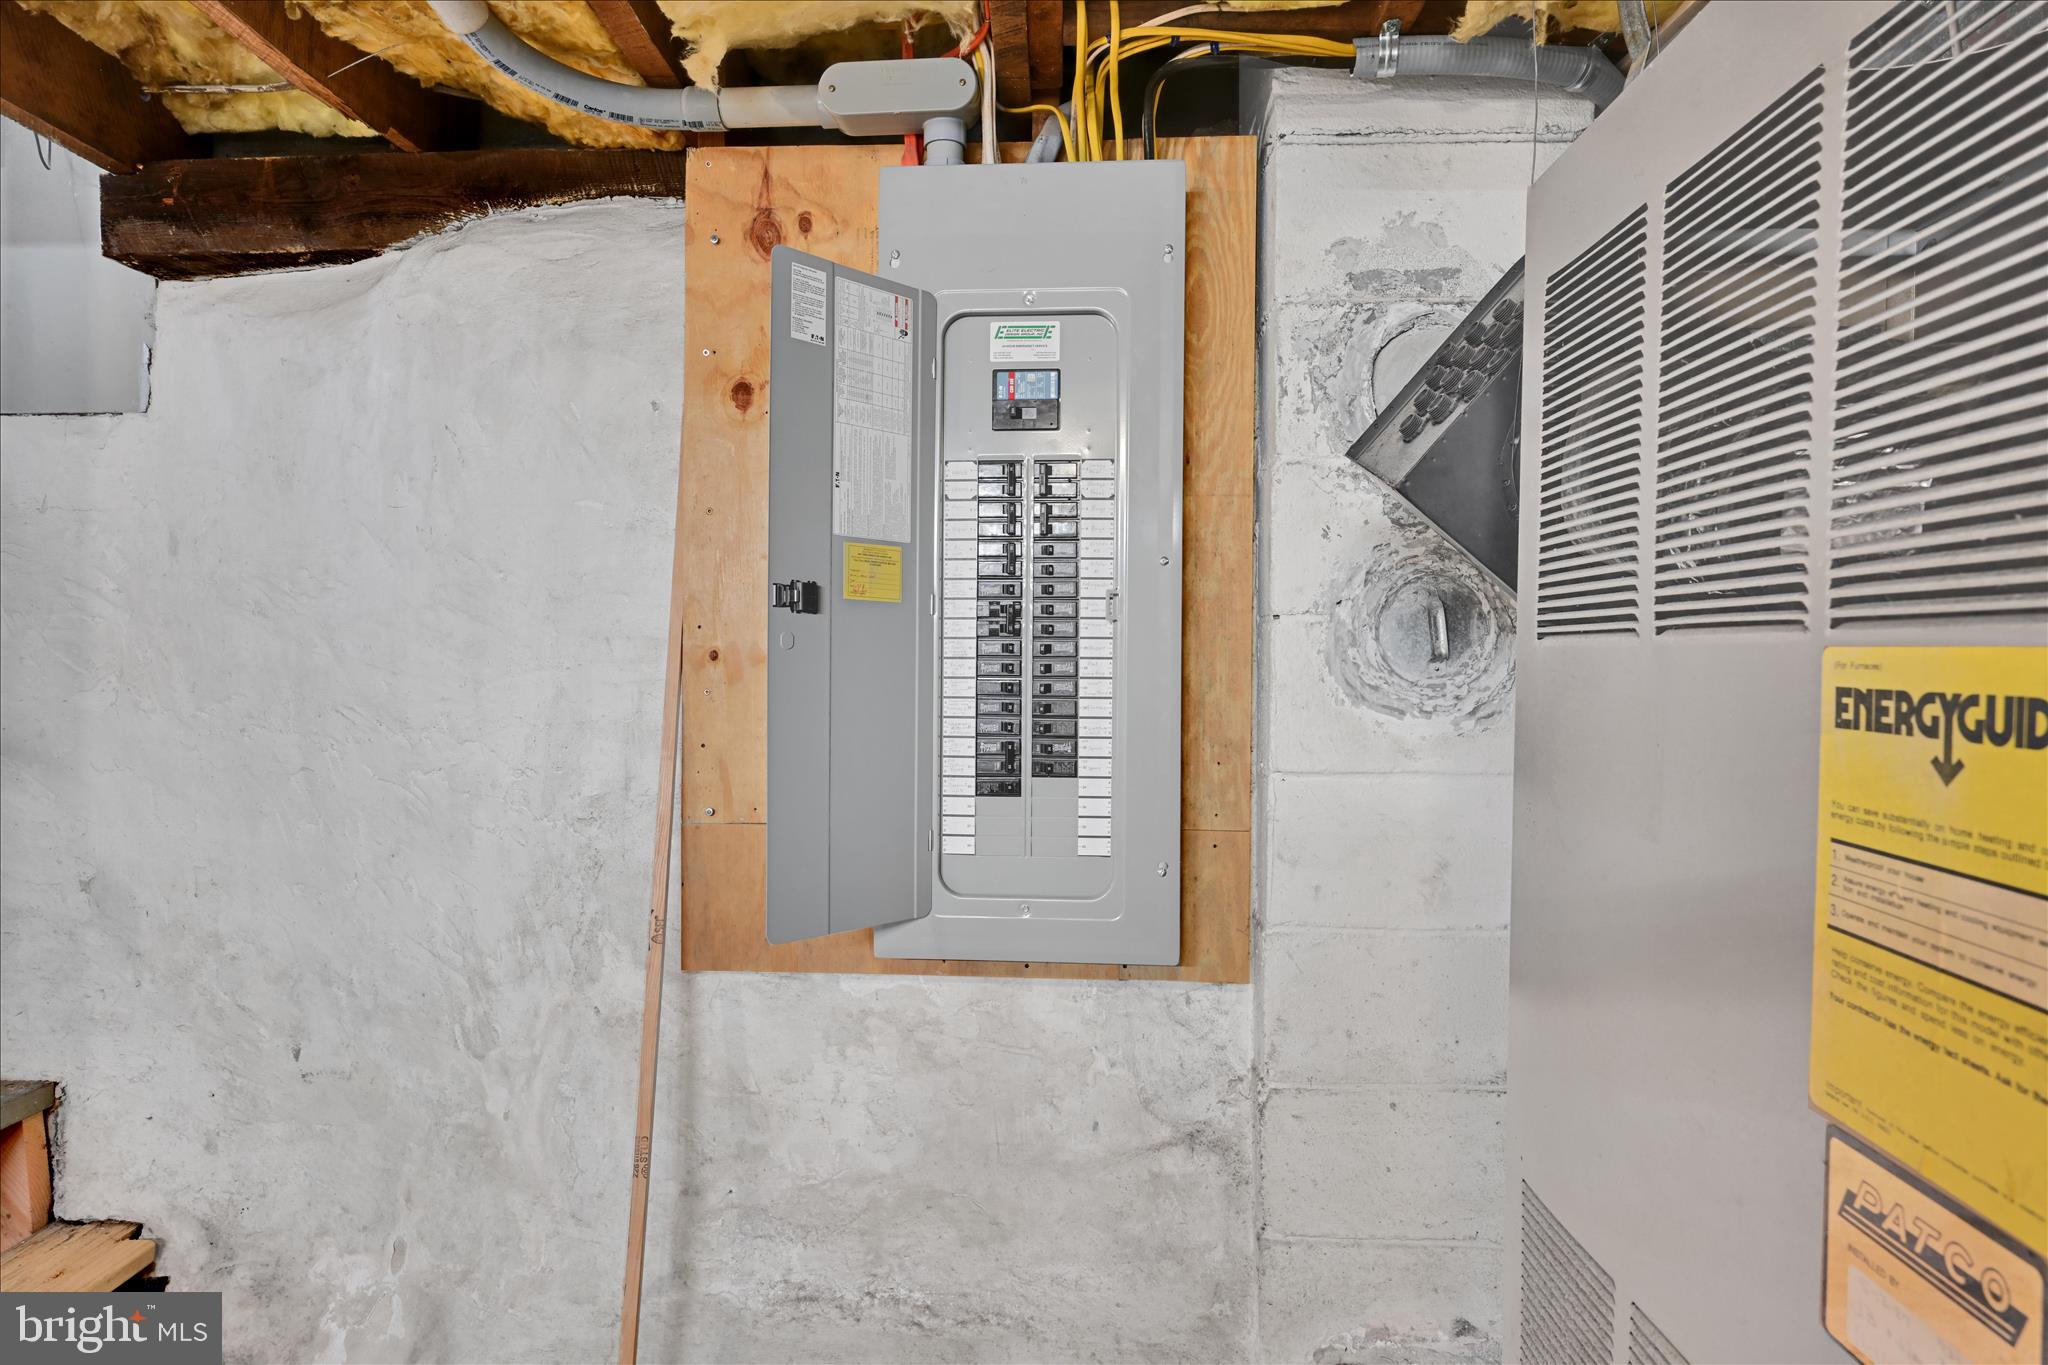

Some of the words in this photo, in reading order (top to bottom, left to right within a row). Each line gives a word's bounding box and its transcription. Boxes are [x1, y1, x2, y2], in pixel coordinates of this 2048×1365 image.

[1831, 811, 1853, 825] energy
[1856, 817, 1875, 829] costs
[1888, 823, 1924, 842] following
[1926, 830, 1940, 844] the
[1942, 835, 1970, 852] simple
[1974, 843, 1998, 859] steps
[2002, 850, 2041, 869] outlined
[1848, 804, 1861, 813] can
[1864, 807, 1879, 818] save
[1883, 811, 1930, 830] substantially
[1950, 825, 1973, 839] home
[1978, 831, 2012, 849] heating
[2017, 840, 2036, 853] and
[1917, 896, 1941, 915] heating
[1945, 907, 1958, 918] and
[1961, 912, 1988, 930] cooling
[1992, 923, 2035, 943] equipment
[1914, 1032, 1940, 1053] energy
[1977, 1009, 2010, 1031] energy
[1855, 1180, 2011, 1314] PATCO
